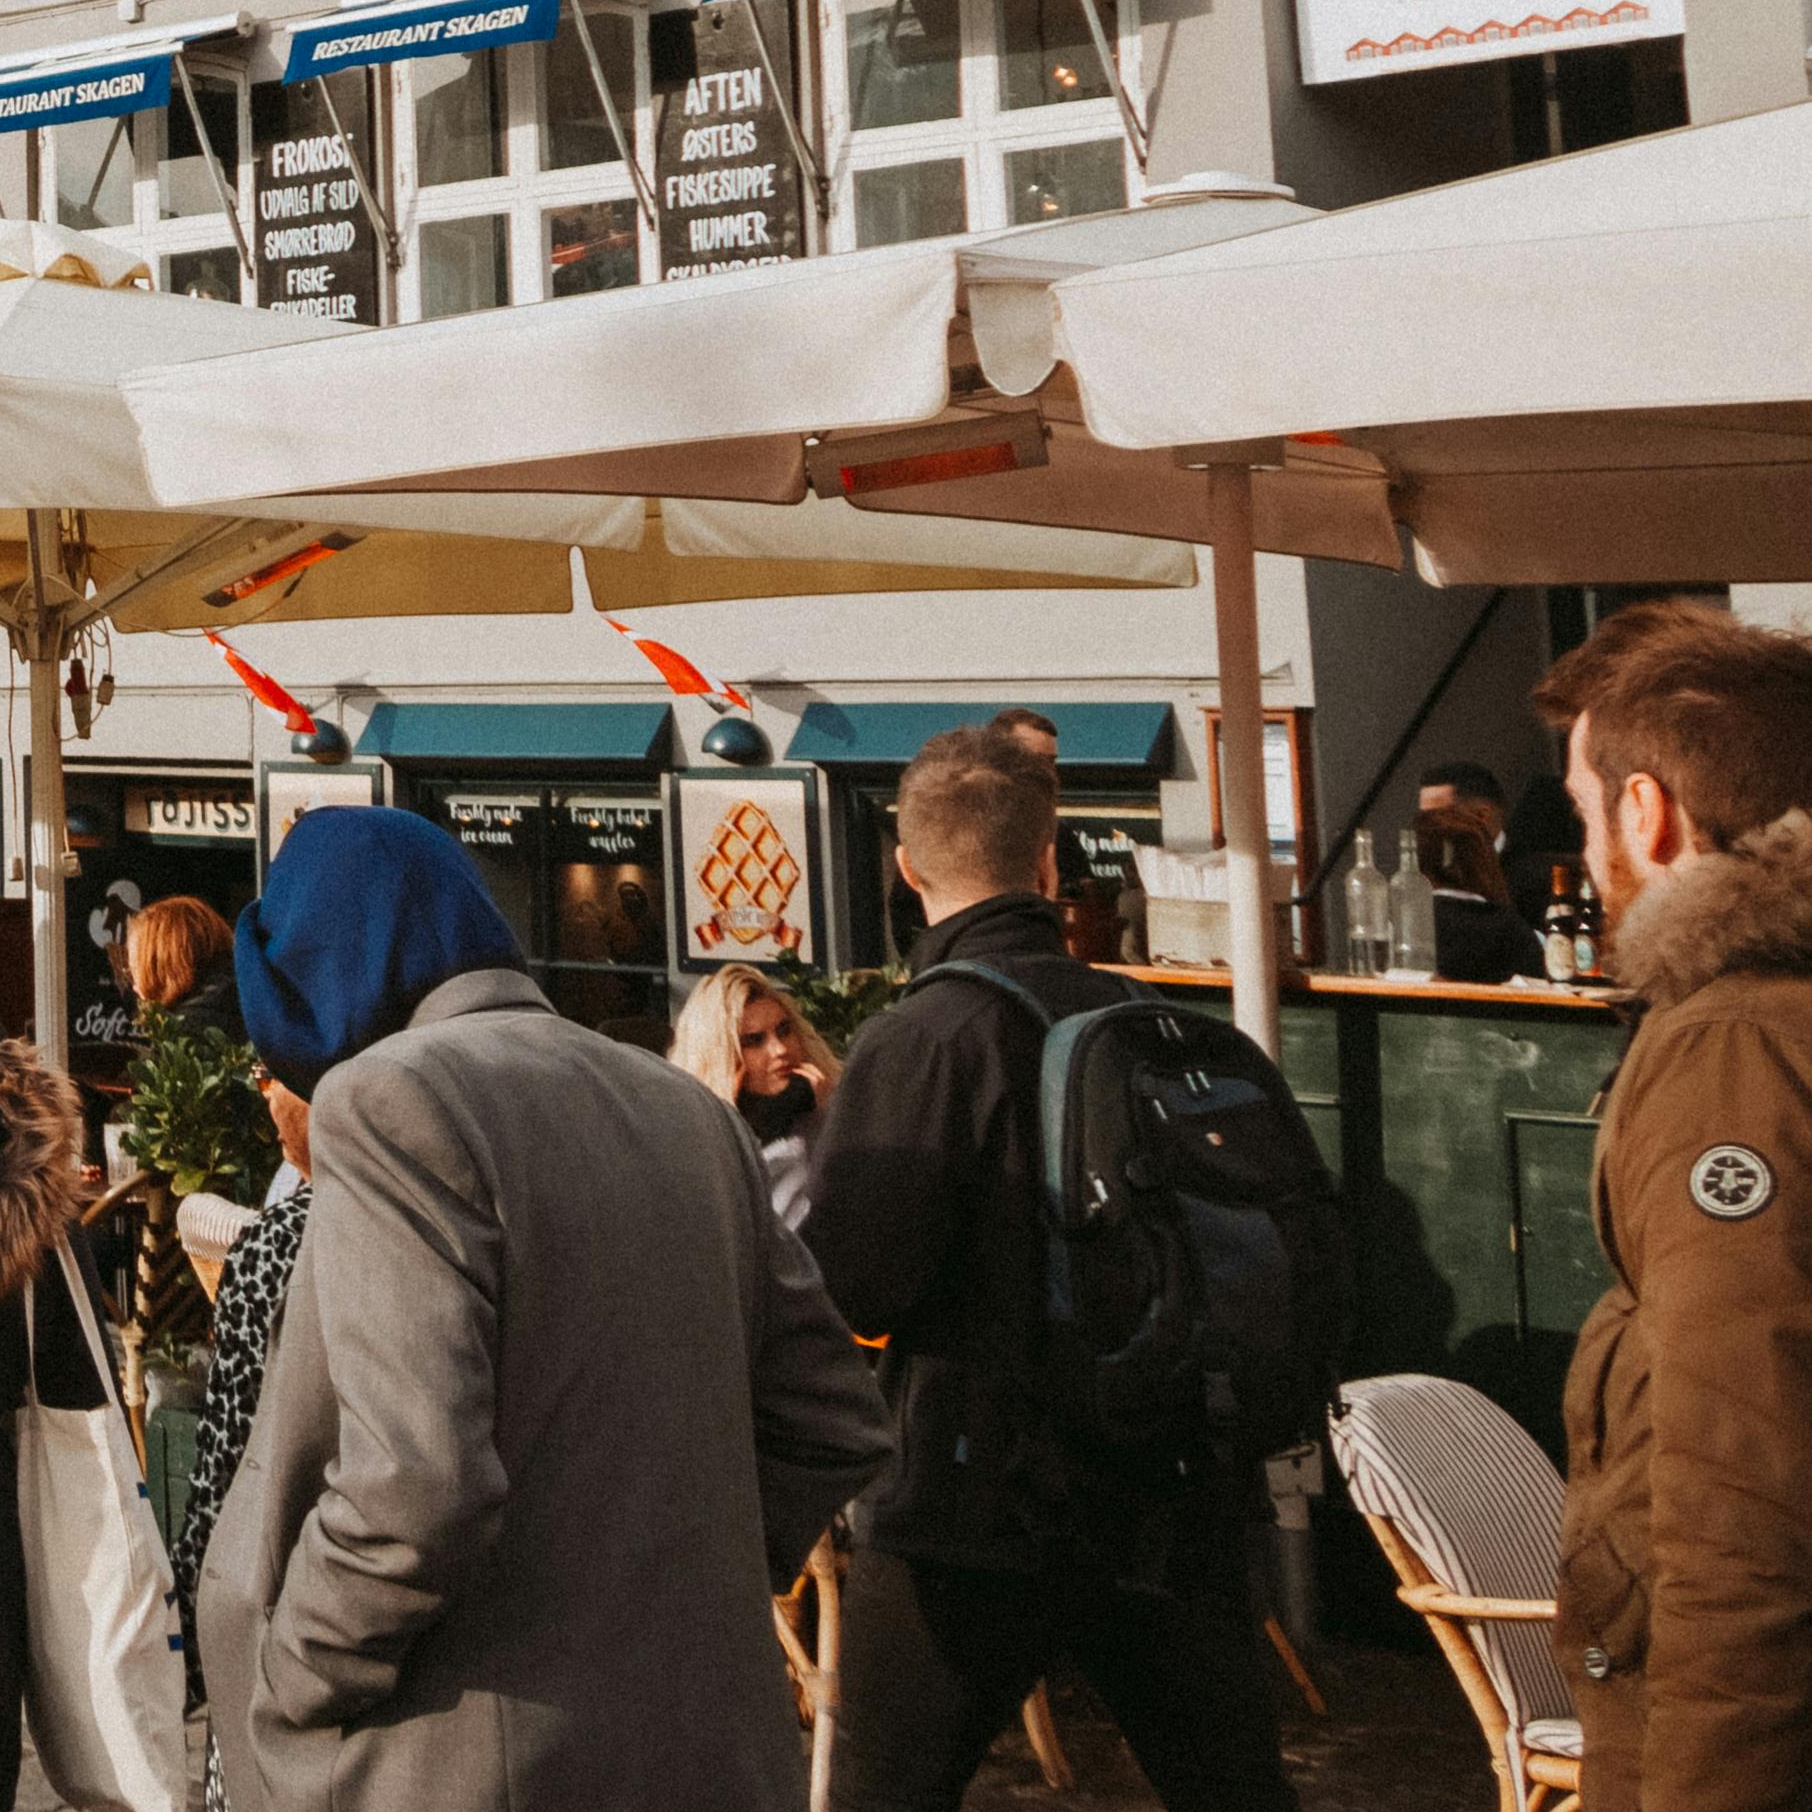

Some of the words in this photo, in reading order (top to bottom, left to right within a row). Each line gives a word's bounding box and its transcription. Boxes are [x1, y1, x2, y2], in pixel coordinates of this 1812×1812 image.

[312, 22, 446, 61] RESTAURANT
[444, 5, 529, 38] SKAGEN
[76, 72, 145, 104] SKAGEN
[684, 67, 762, 116] AFTEN
[681, 121, 757, 162] ØSTERS
[260, 185, 310, 220] UDVALG
[312, 183, 327, 214] AF
[329, 179, 360, 211] SILD
[665, 163, 776, 210] FISKESUPPE
[264, 221, 356, 261] SMØRREBRØD
[689, 211, 771, 252] HUMMER
[286, 265, 336, 295] FISKE-
[76, 1003, 129, 1042] Soft
